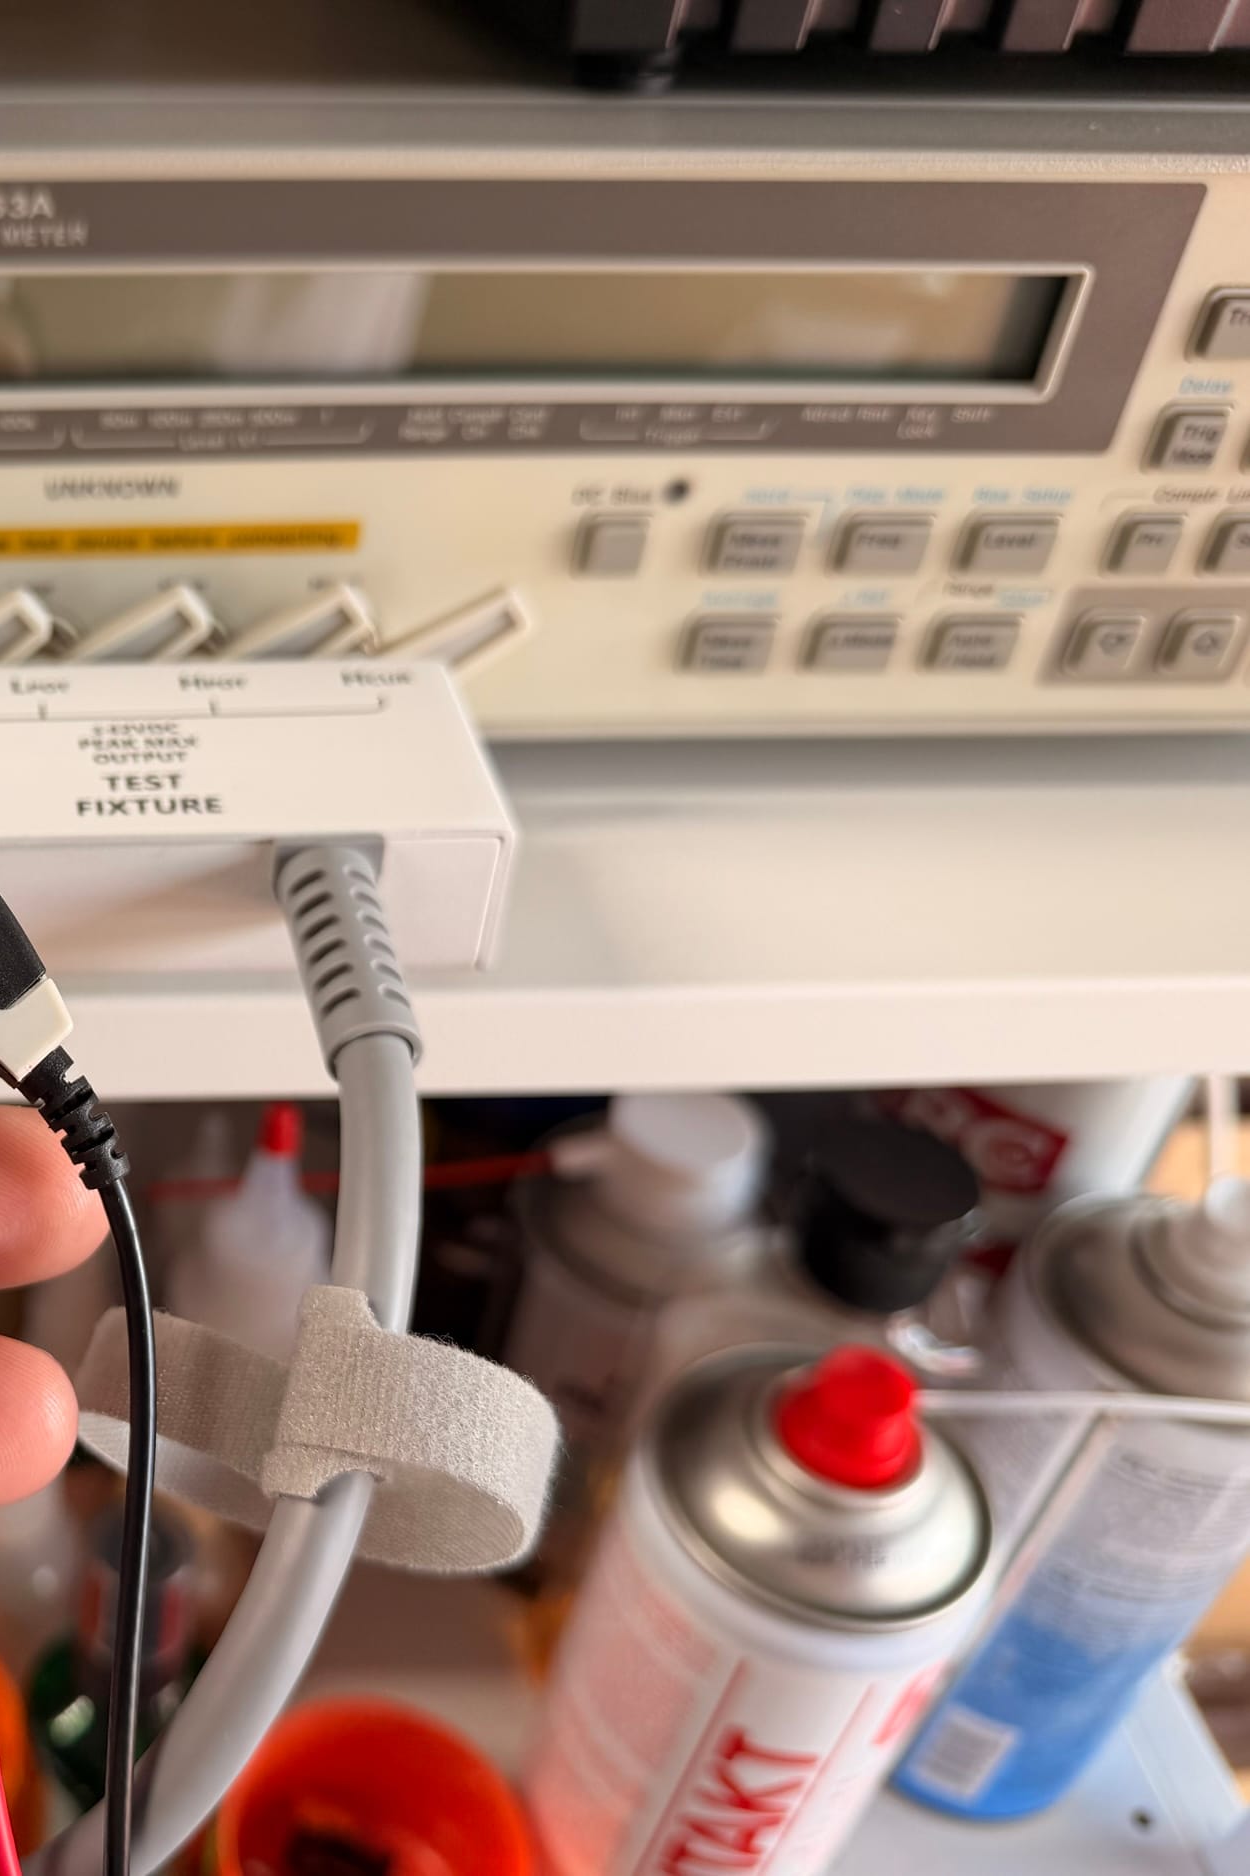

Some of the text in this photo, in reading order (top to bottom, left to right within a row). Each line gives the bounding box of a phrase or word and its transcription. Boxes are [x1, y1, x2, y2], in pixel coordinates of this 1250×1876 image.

[0, 220, 89, 247] METER
[44, 475, 179, 499] UNKNOWN
[92, 751, 188, 765] OUTPUT
[101, 772, 183, 792] TEST
[76, 797, 225, 817] FIXTURE
